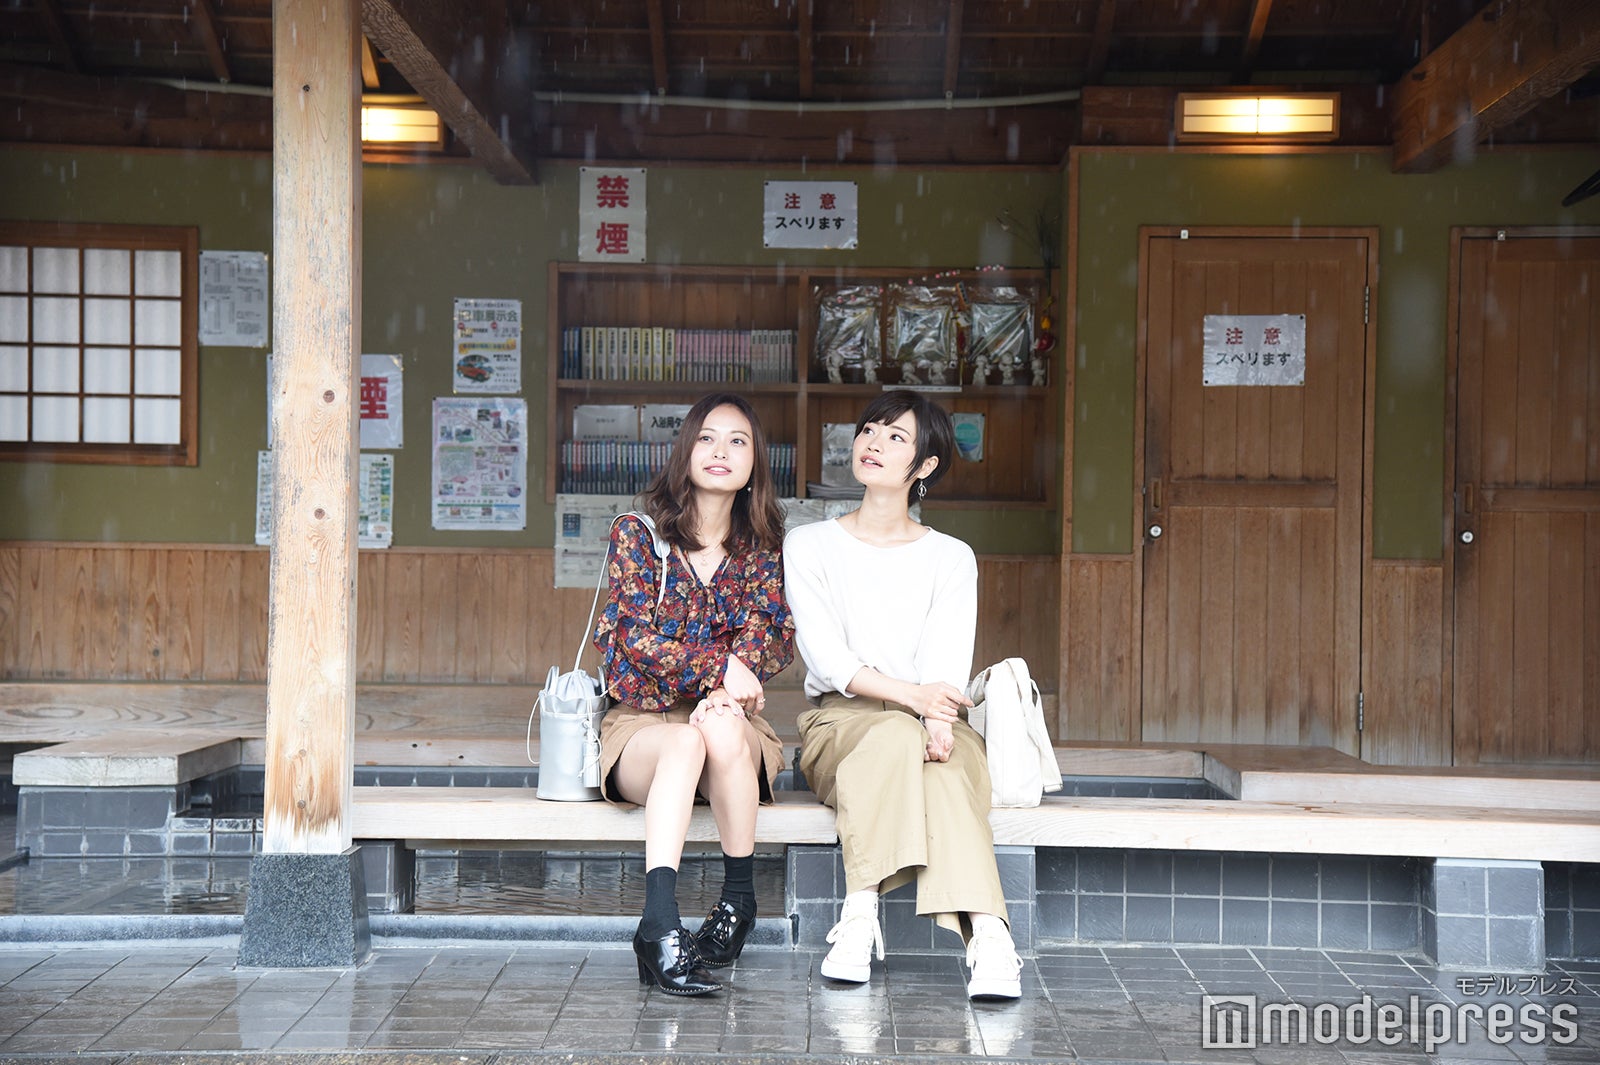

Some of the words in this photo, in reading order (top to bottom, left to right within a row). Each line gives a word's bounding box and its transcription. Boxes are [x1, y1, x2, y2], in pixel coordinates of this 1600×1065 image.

[596, 175, 629, 254] 禁煙
[775, 217, 846, 230] スベリます
[1216, 353, 1291, 366] スベリます
